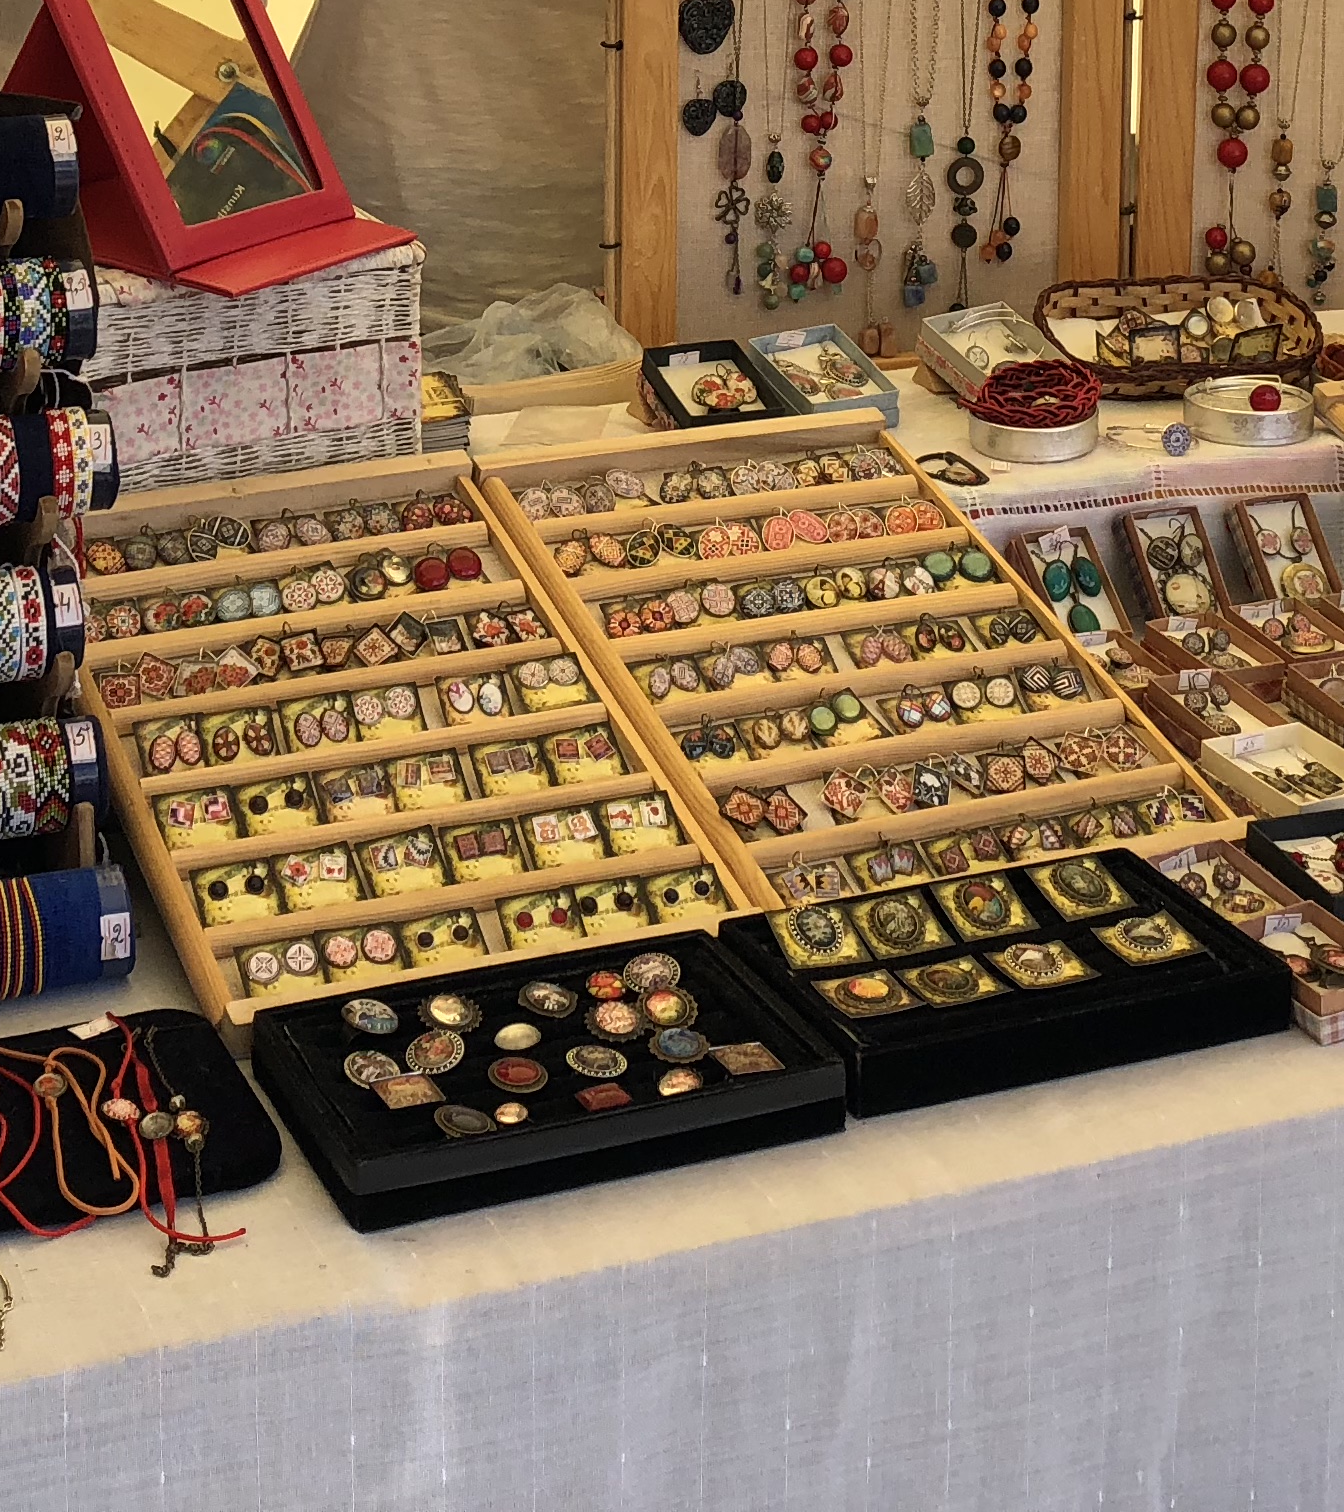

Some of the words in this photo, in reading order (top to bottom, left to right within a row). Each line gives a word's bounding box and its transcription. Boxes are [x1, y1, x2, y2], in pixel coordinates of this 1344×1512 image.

[54, 125, 66, 141] 2
[92, 430, 103, 451] 3
[59, 591, 71, 614] 4
[72, 726, 91, 747] 5
[110, 923, 125, 944] 2
